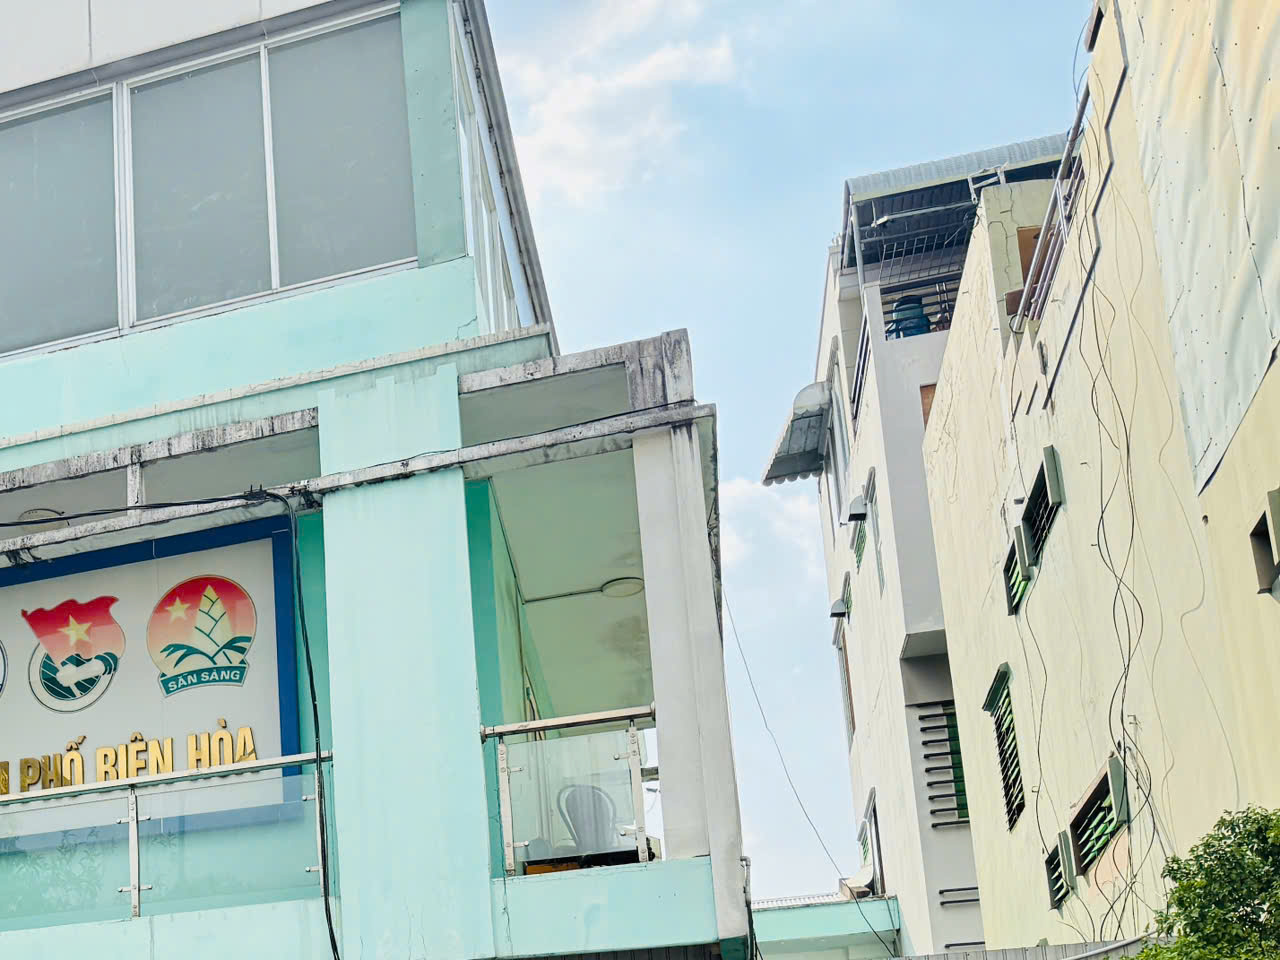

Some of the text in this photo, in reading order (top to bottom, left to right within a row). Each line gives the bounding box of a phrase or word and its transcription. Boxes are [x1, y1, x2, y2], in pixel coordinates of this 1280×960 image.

[20, 735, 87, 793] PHỐ
[96, 731, 174, 783] BIÊN
[187, 718, 258, 769] HÒA
